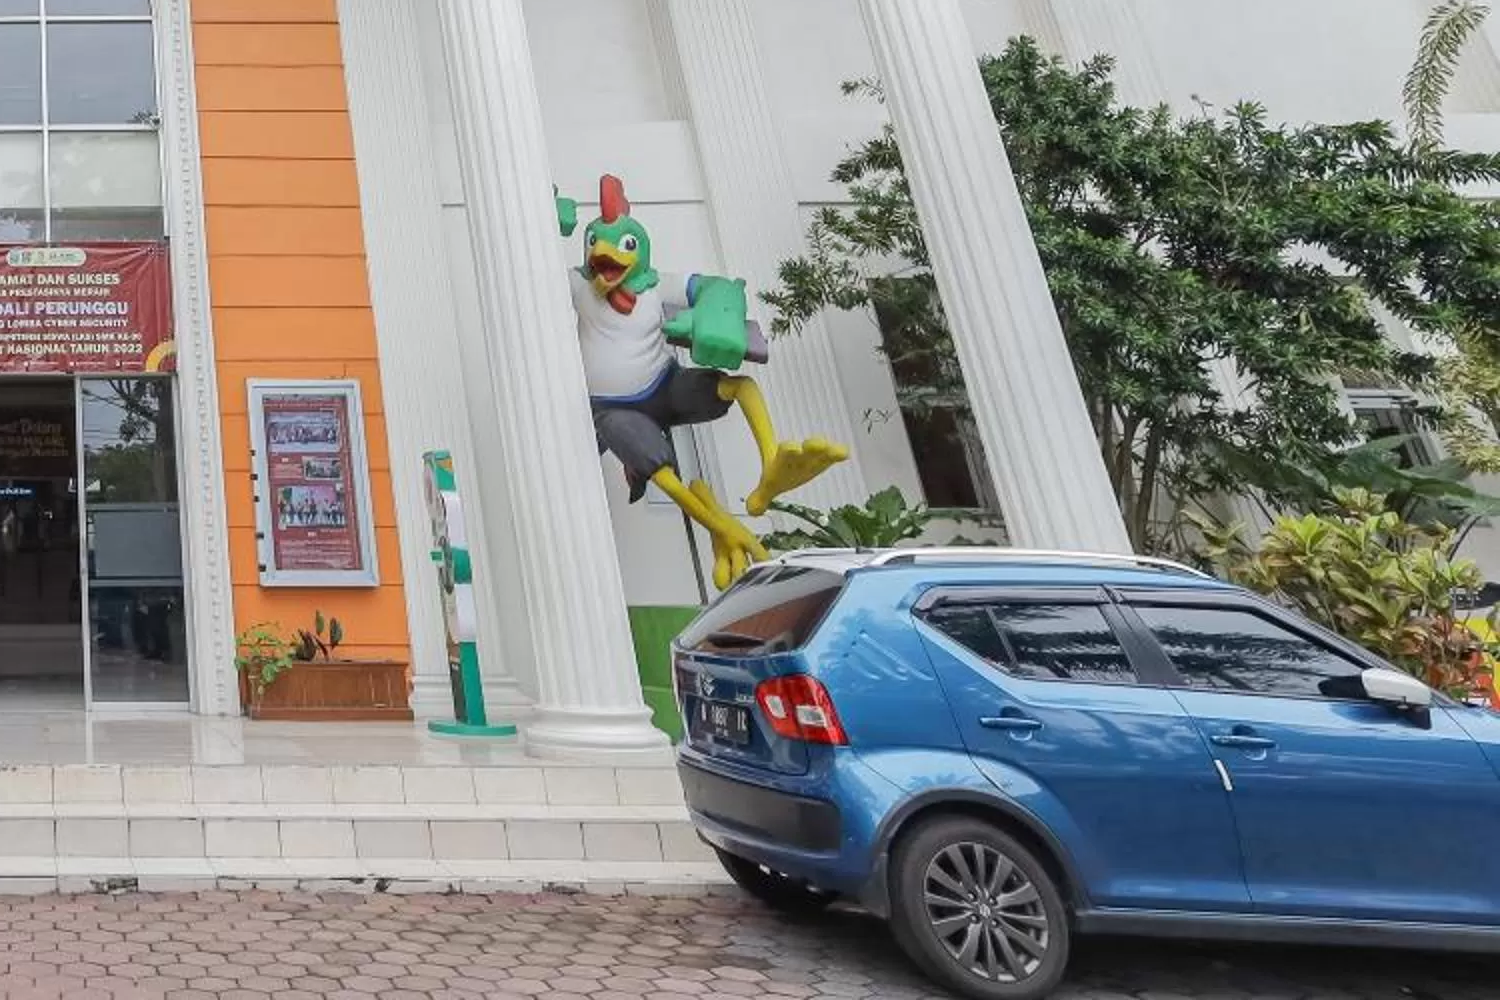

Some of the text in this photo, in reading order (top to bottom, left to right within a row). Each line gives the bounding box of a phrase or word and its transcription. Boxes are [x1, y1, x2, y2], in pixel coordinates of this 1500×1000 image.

[37, 274, 64, 285] DAN
[68, 273, 121, 285] SUKSES
[35, 301, 128, 315] PERUNGGU
[7, 319, 42, 329] LOMBA
[45, 319, 77, 328] CYBER
[79, 318, 128, 327] SECURITY
[7, 344, 66, 354] NASIONAL
[70, 343, 109, 353] TAHUN
[114, 343, 143, 353] 2022
